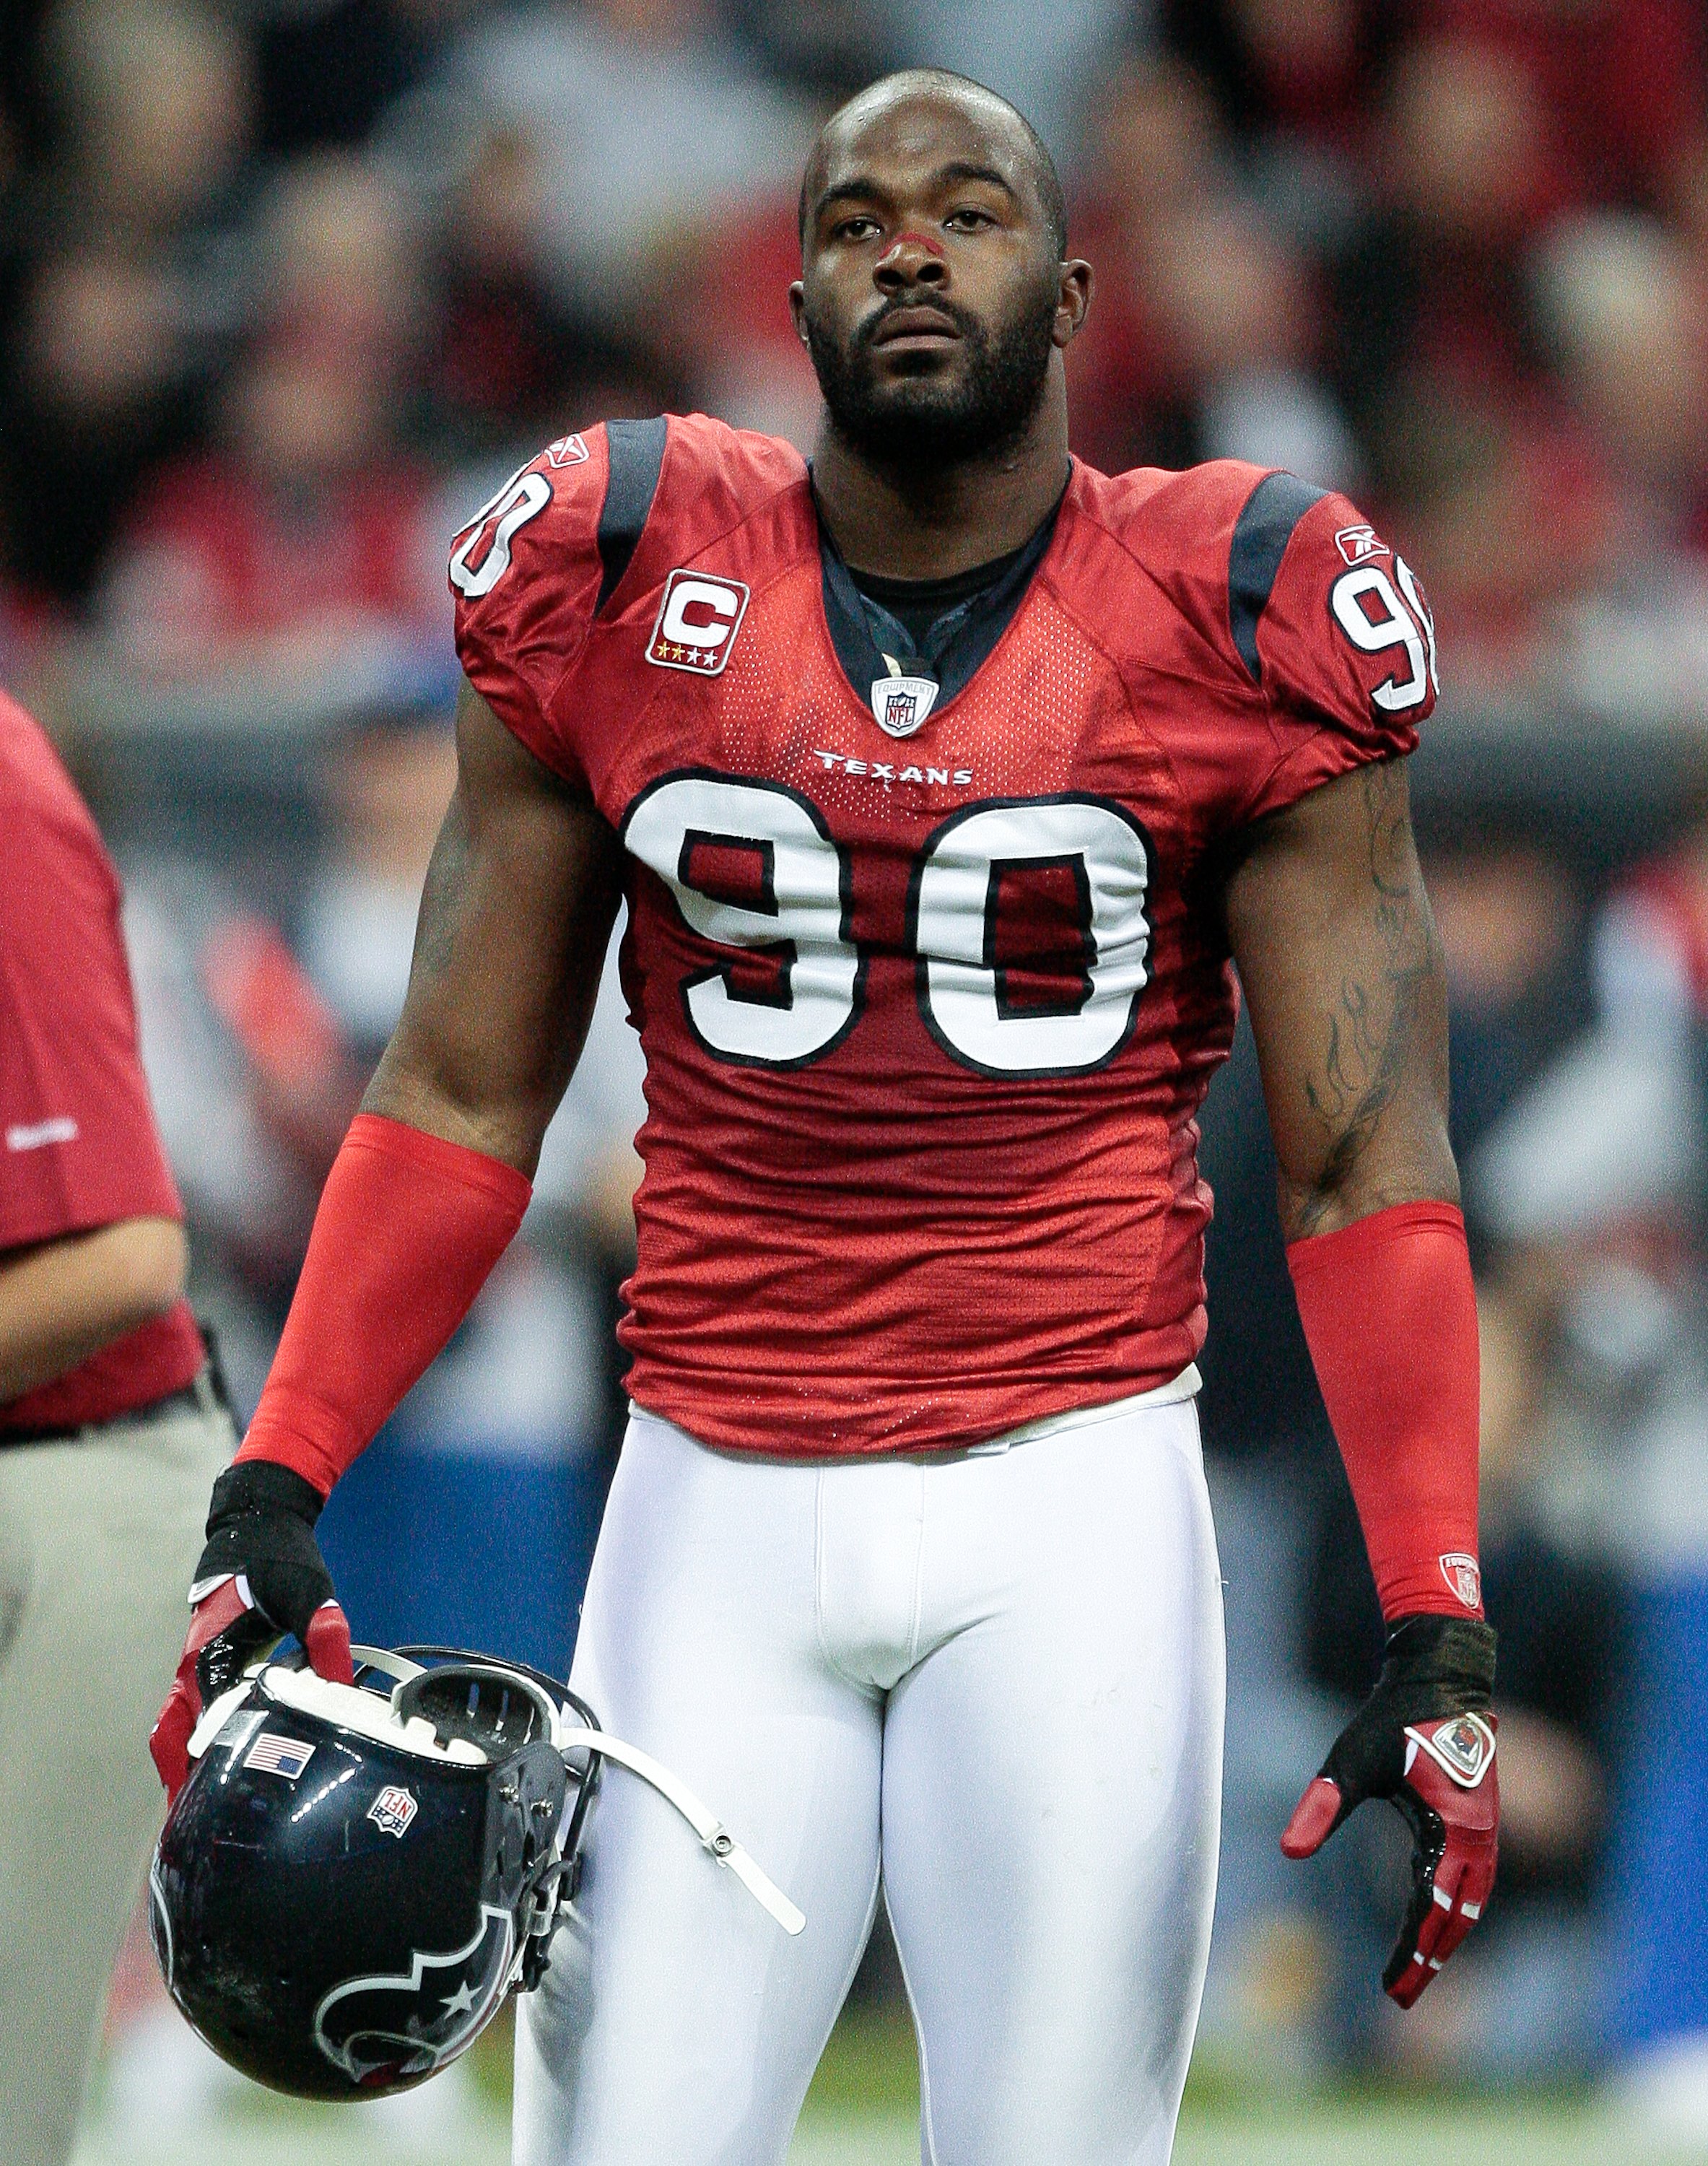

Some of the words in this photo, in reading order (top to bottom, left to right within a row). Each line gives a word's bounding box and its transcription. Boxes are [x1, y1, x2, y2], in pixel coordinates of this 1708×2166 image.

[449, 453, 553, 599] 0
[663, 580, 738, 648] C
[888, 706, 912, 726] NFL
[814, 749, 975, 786] TEXANS
[619, 768, 1157, 1079] 90
[384, 1792, 412, 1819] NFL
